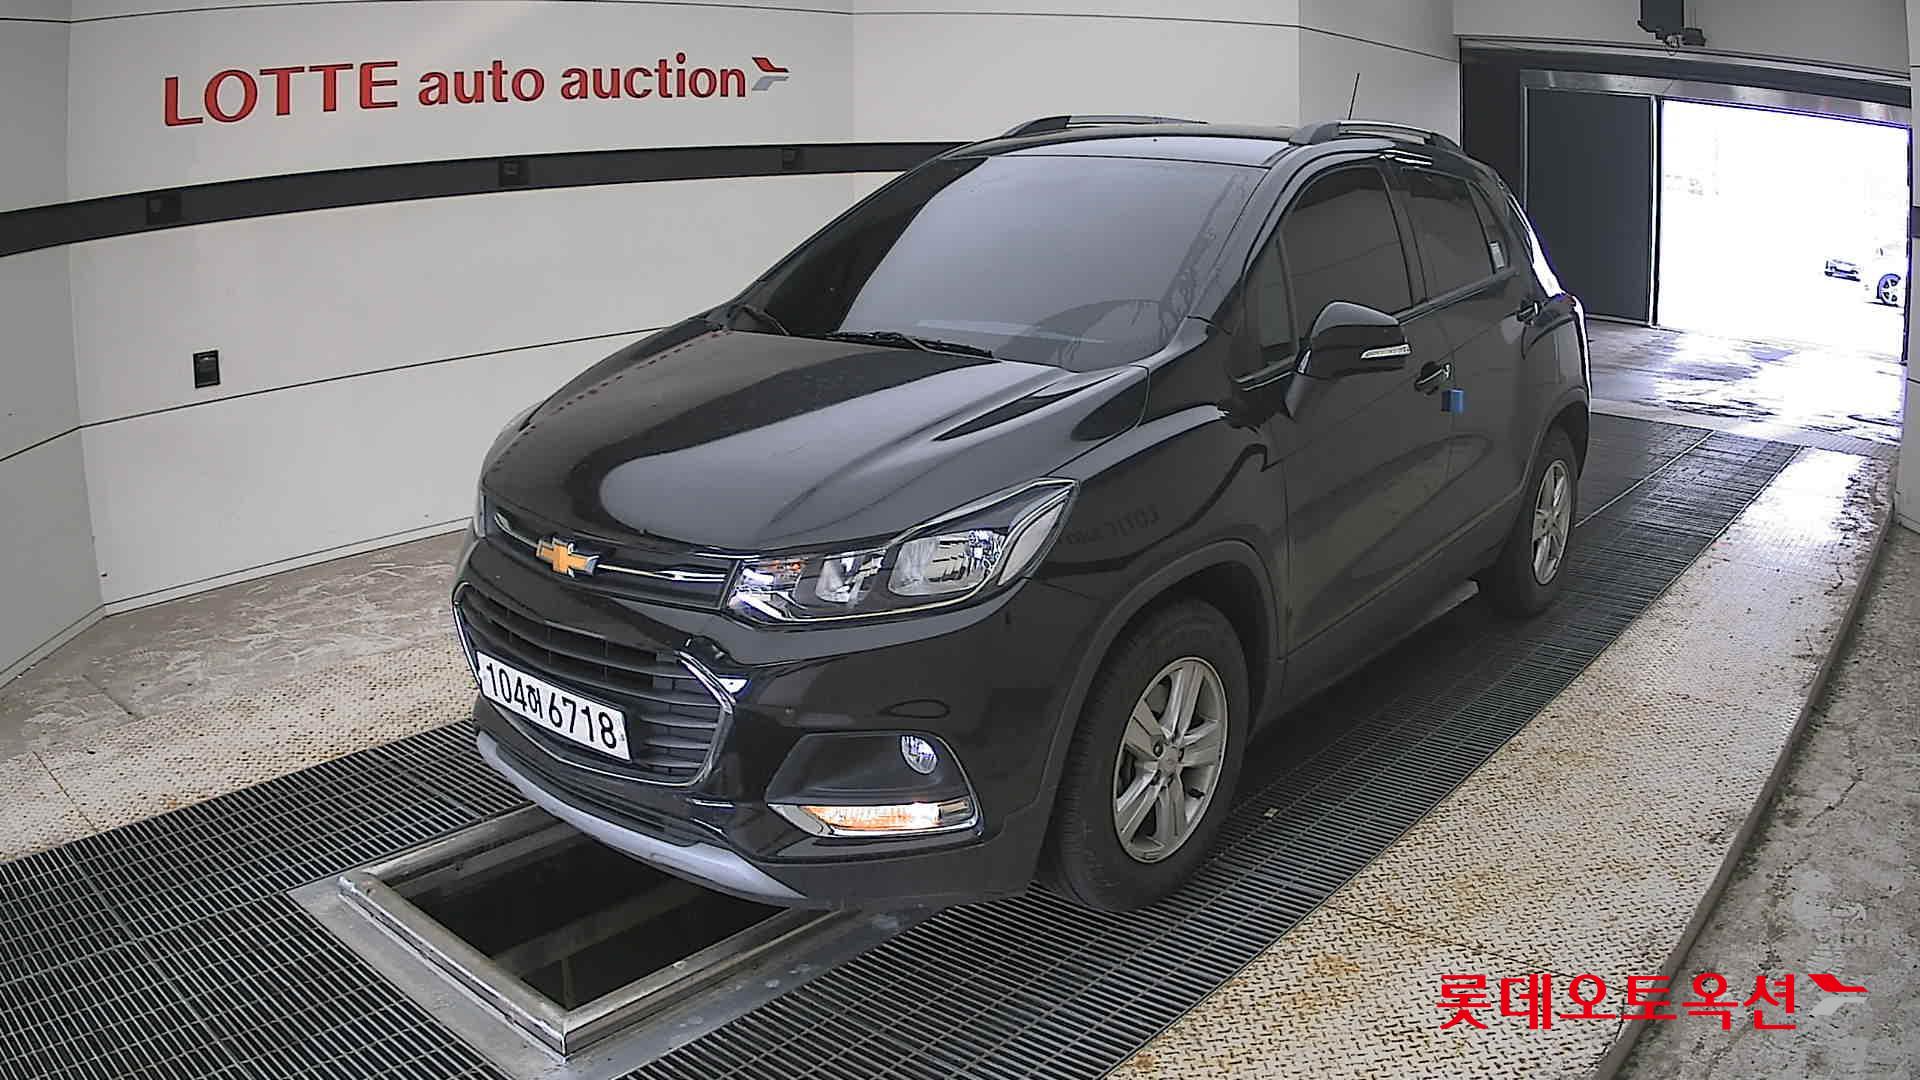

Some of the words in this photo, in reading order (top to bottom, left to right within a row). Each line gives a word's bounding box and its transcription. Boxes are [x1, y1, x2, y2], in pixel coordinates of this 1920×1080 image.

[164, 60, 399, 127] LOTTE
[417, 59, 545, 106] auto
[560, 52, 747, 99] auction
